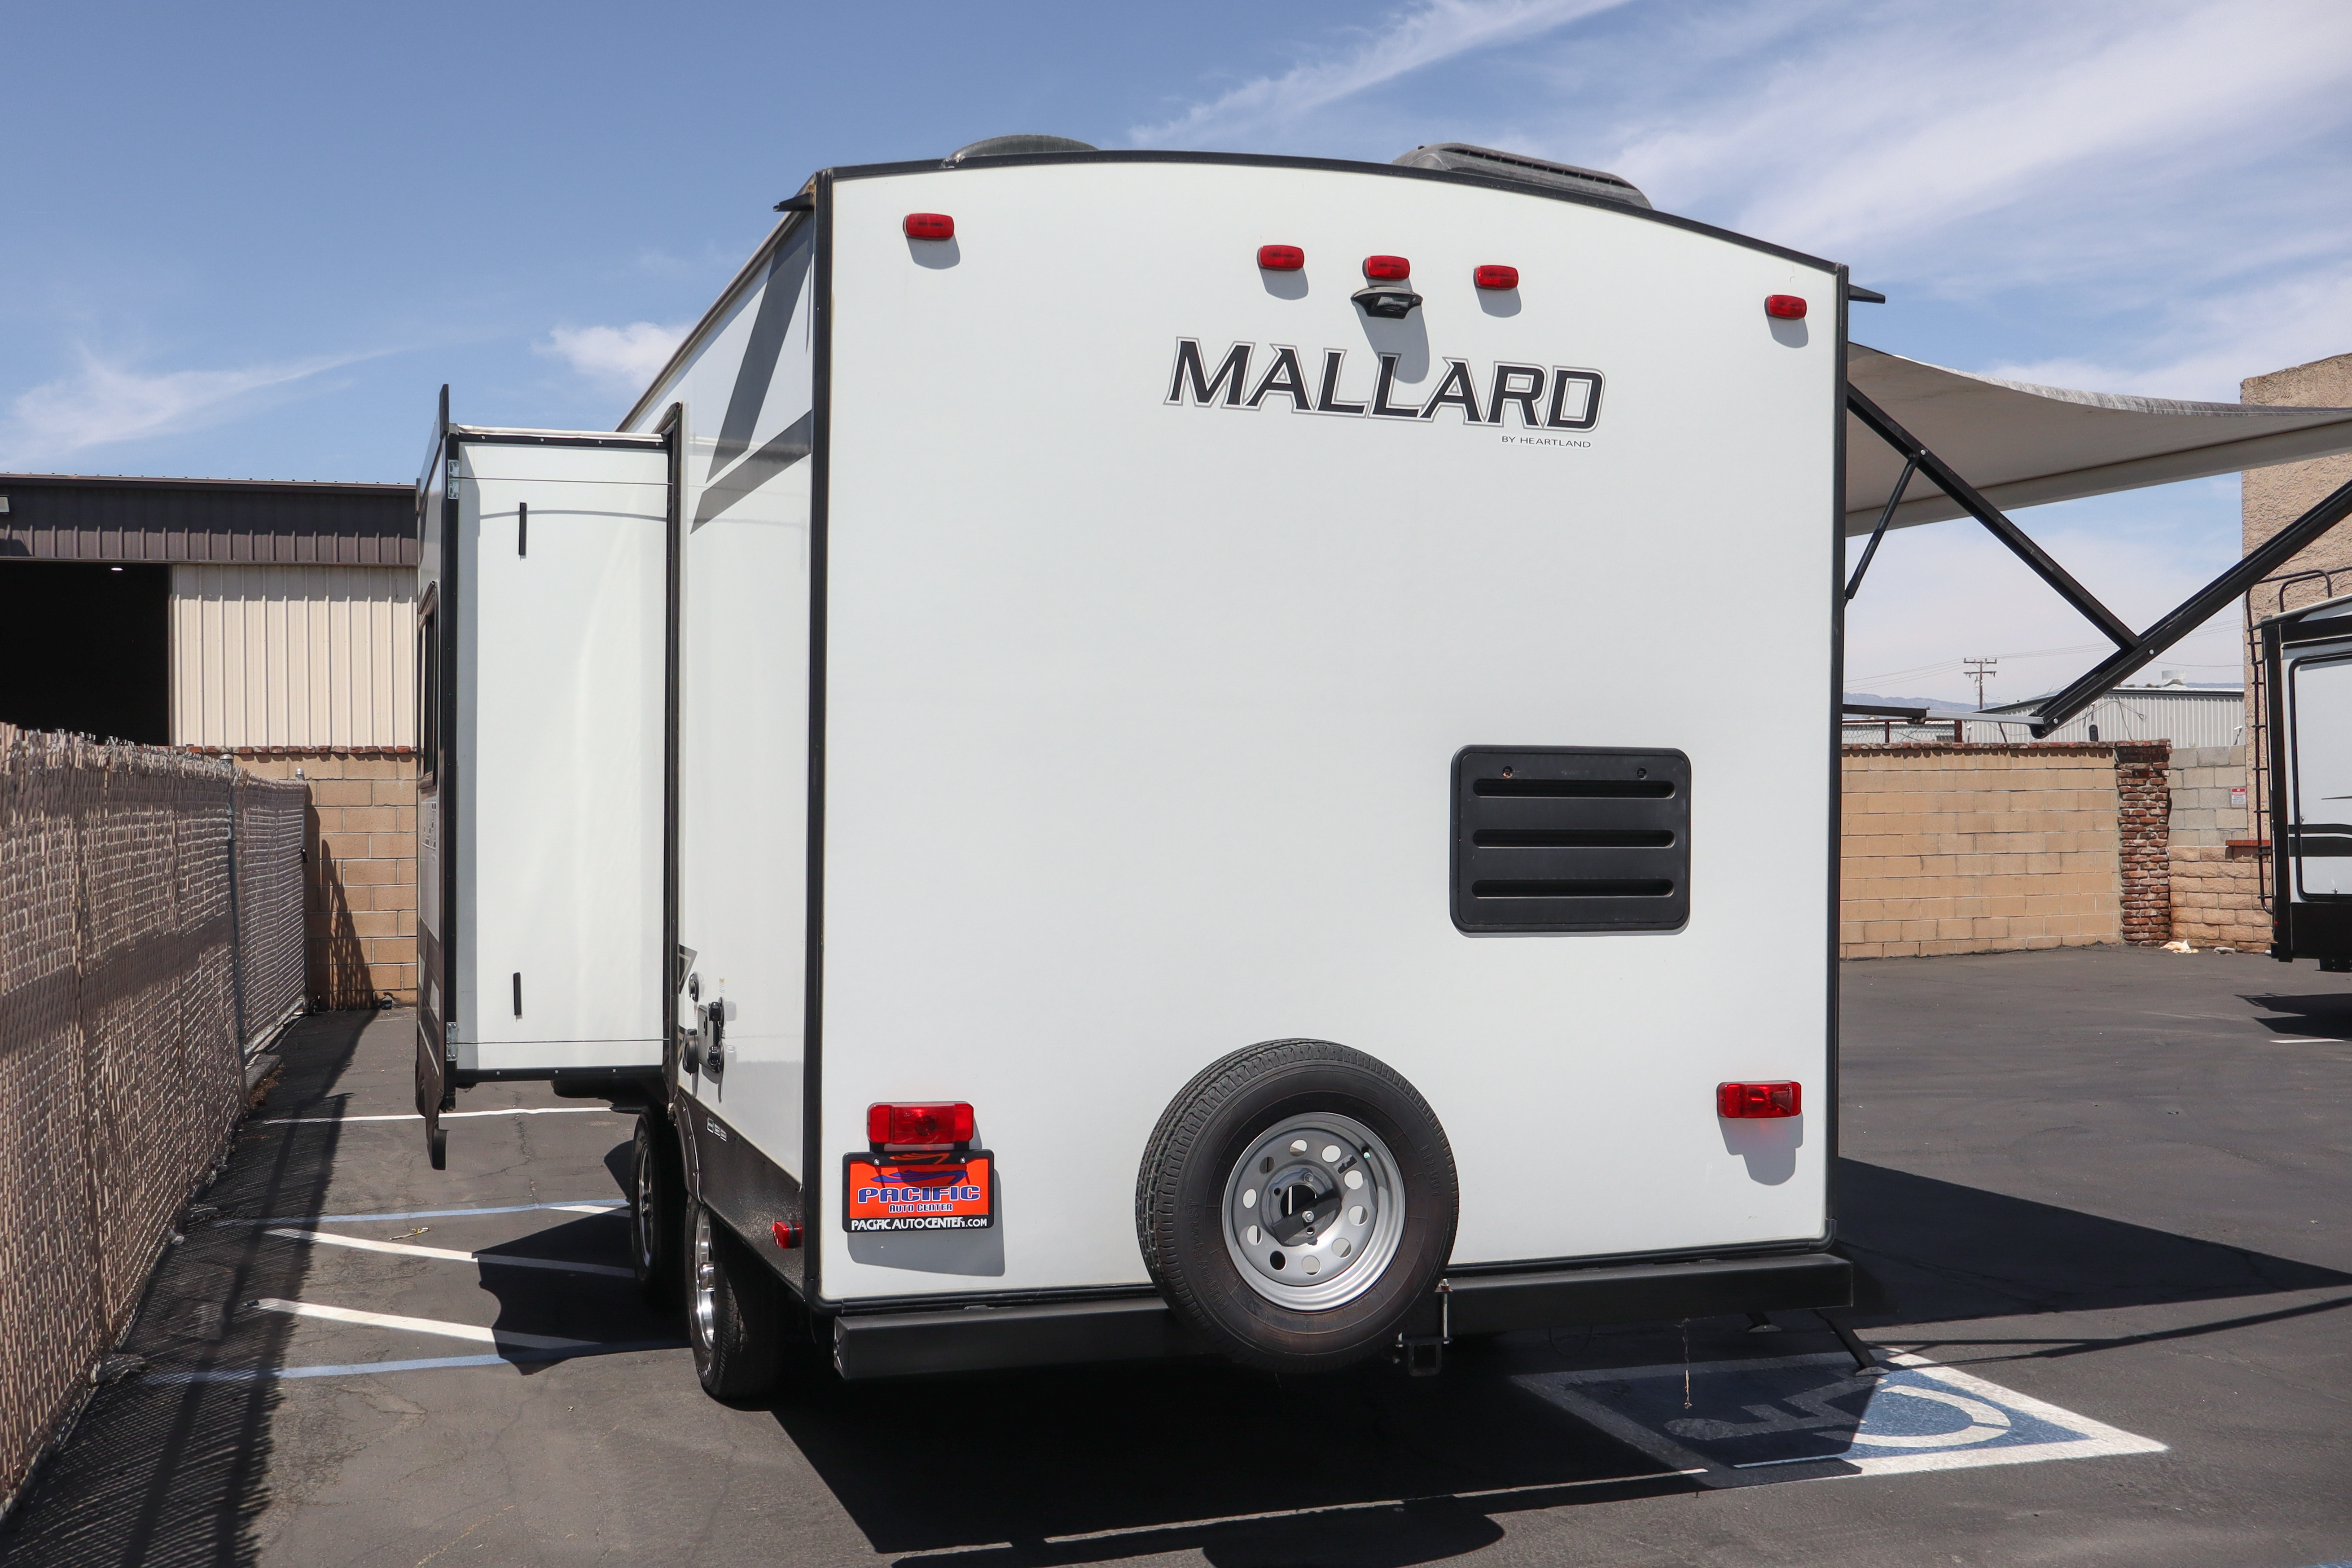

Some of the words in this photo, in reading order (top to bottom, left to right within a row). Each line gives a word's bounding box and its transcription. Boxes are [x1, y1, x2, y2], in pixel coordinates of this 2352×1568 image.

[1163, 336, 1605, 433] MALLARD
[1520, 437, 1591, 448] HEARTLAND
[857, 1185, 980, 1203] PACIFIC
[889, 1204, 914, 1213] AUTO
[917, 1203, 953, 1212] CENTER
[1189, 1199, 1200, 1218] ST
[851, 1217, 987, 1231] PACIFICAUTOCENTER.COM
[1189, 1221, 1204, 1258] Sport
